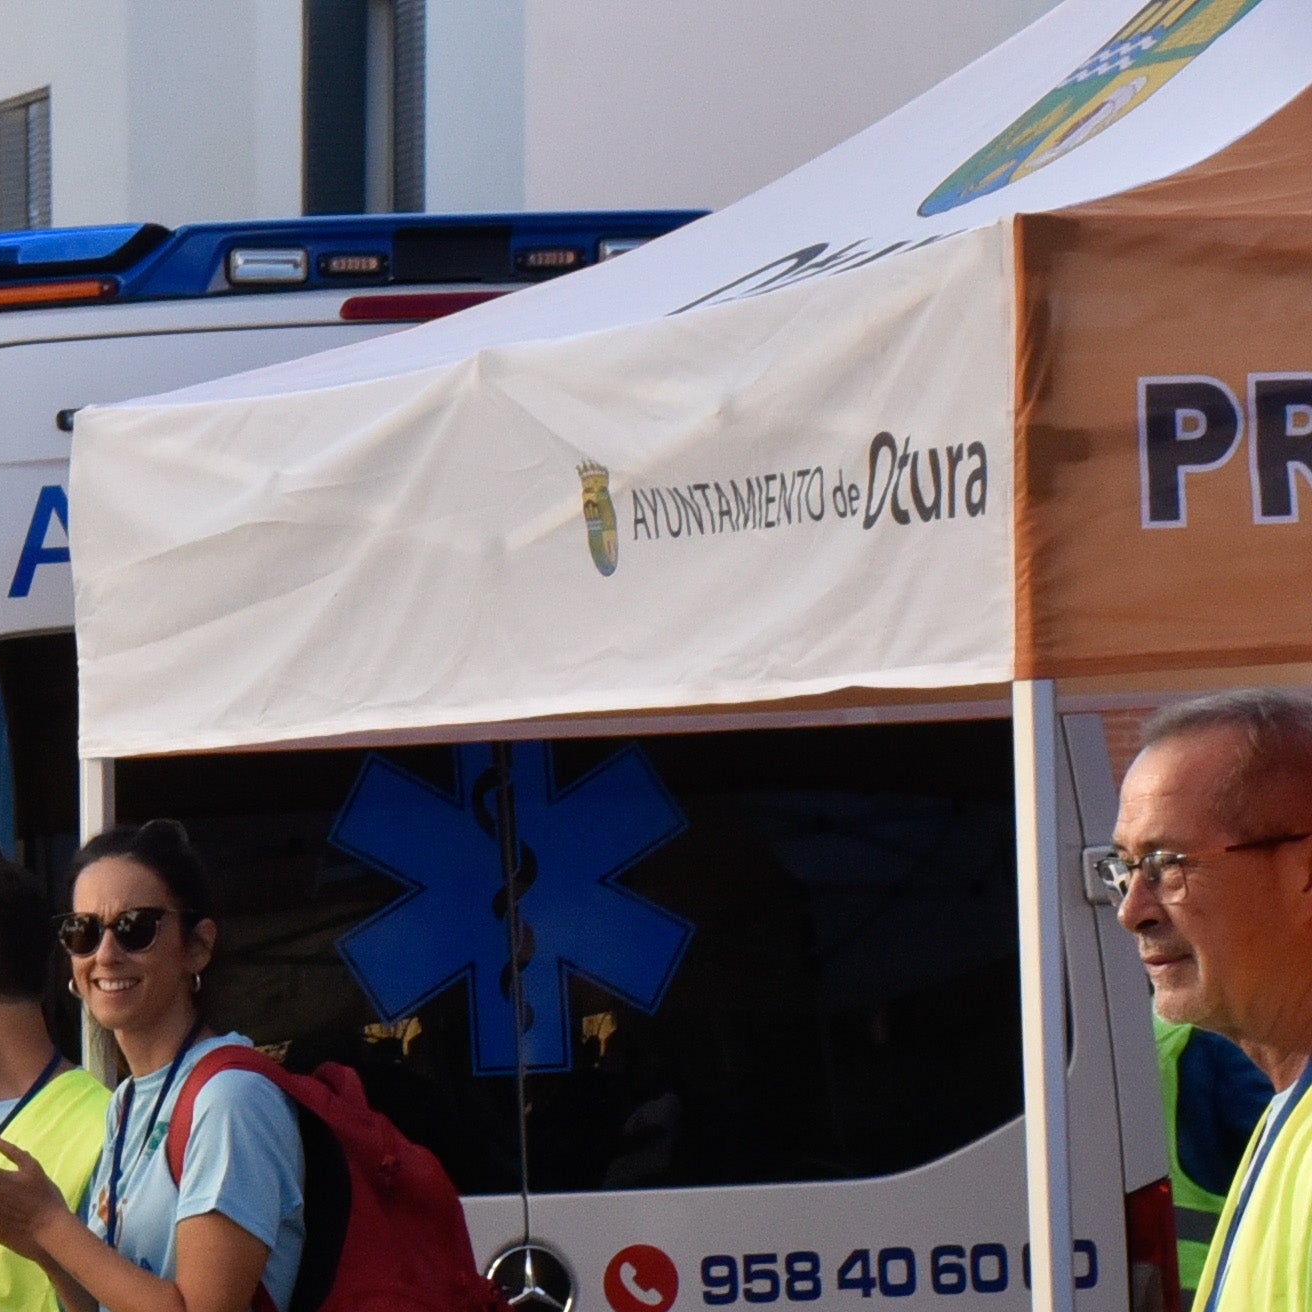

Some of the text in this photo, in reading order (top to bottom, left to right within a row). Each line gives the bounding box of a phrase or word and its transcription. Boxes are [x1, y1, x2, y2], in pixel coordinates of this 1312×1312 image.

[631, 465, 826, 543] AYUNTAMIENTO
[832, 469, 861, 524] de
[699, 1238, 1099, 1307] 958 40 60 0
